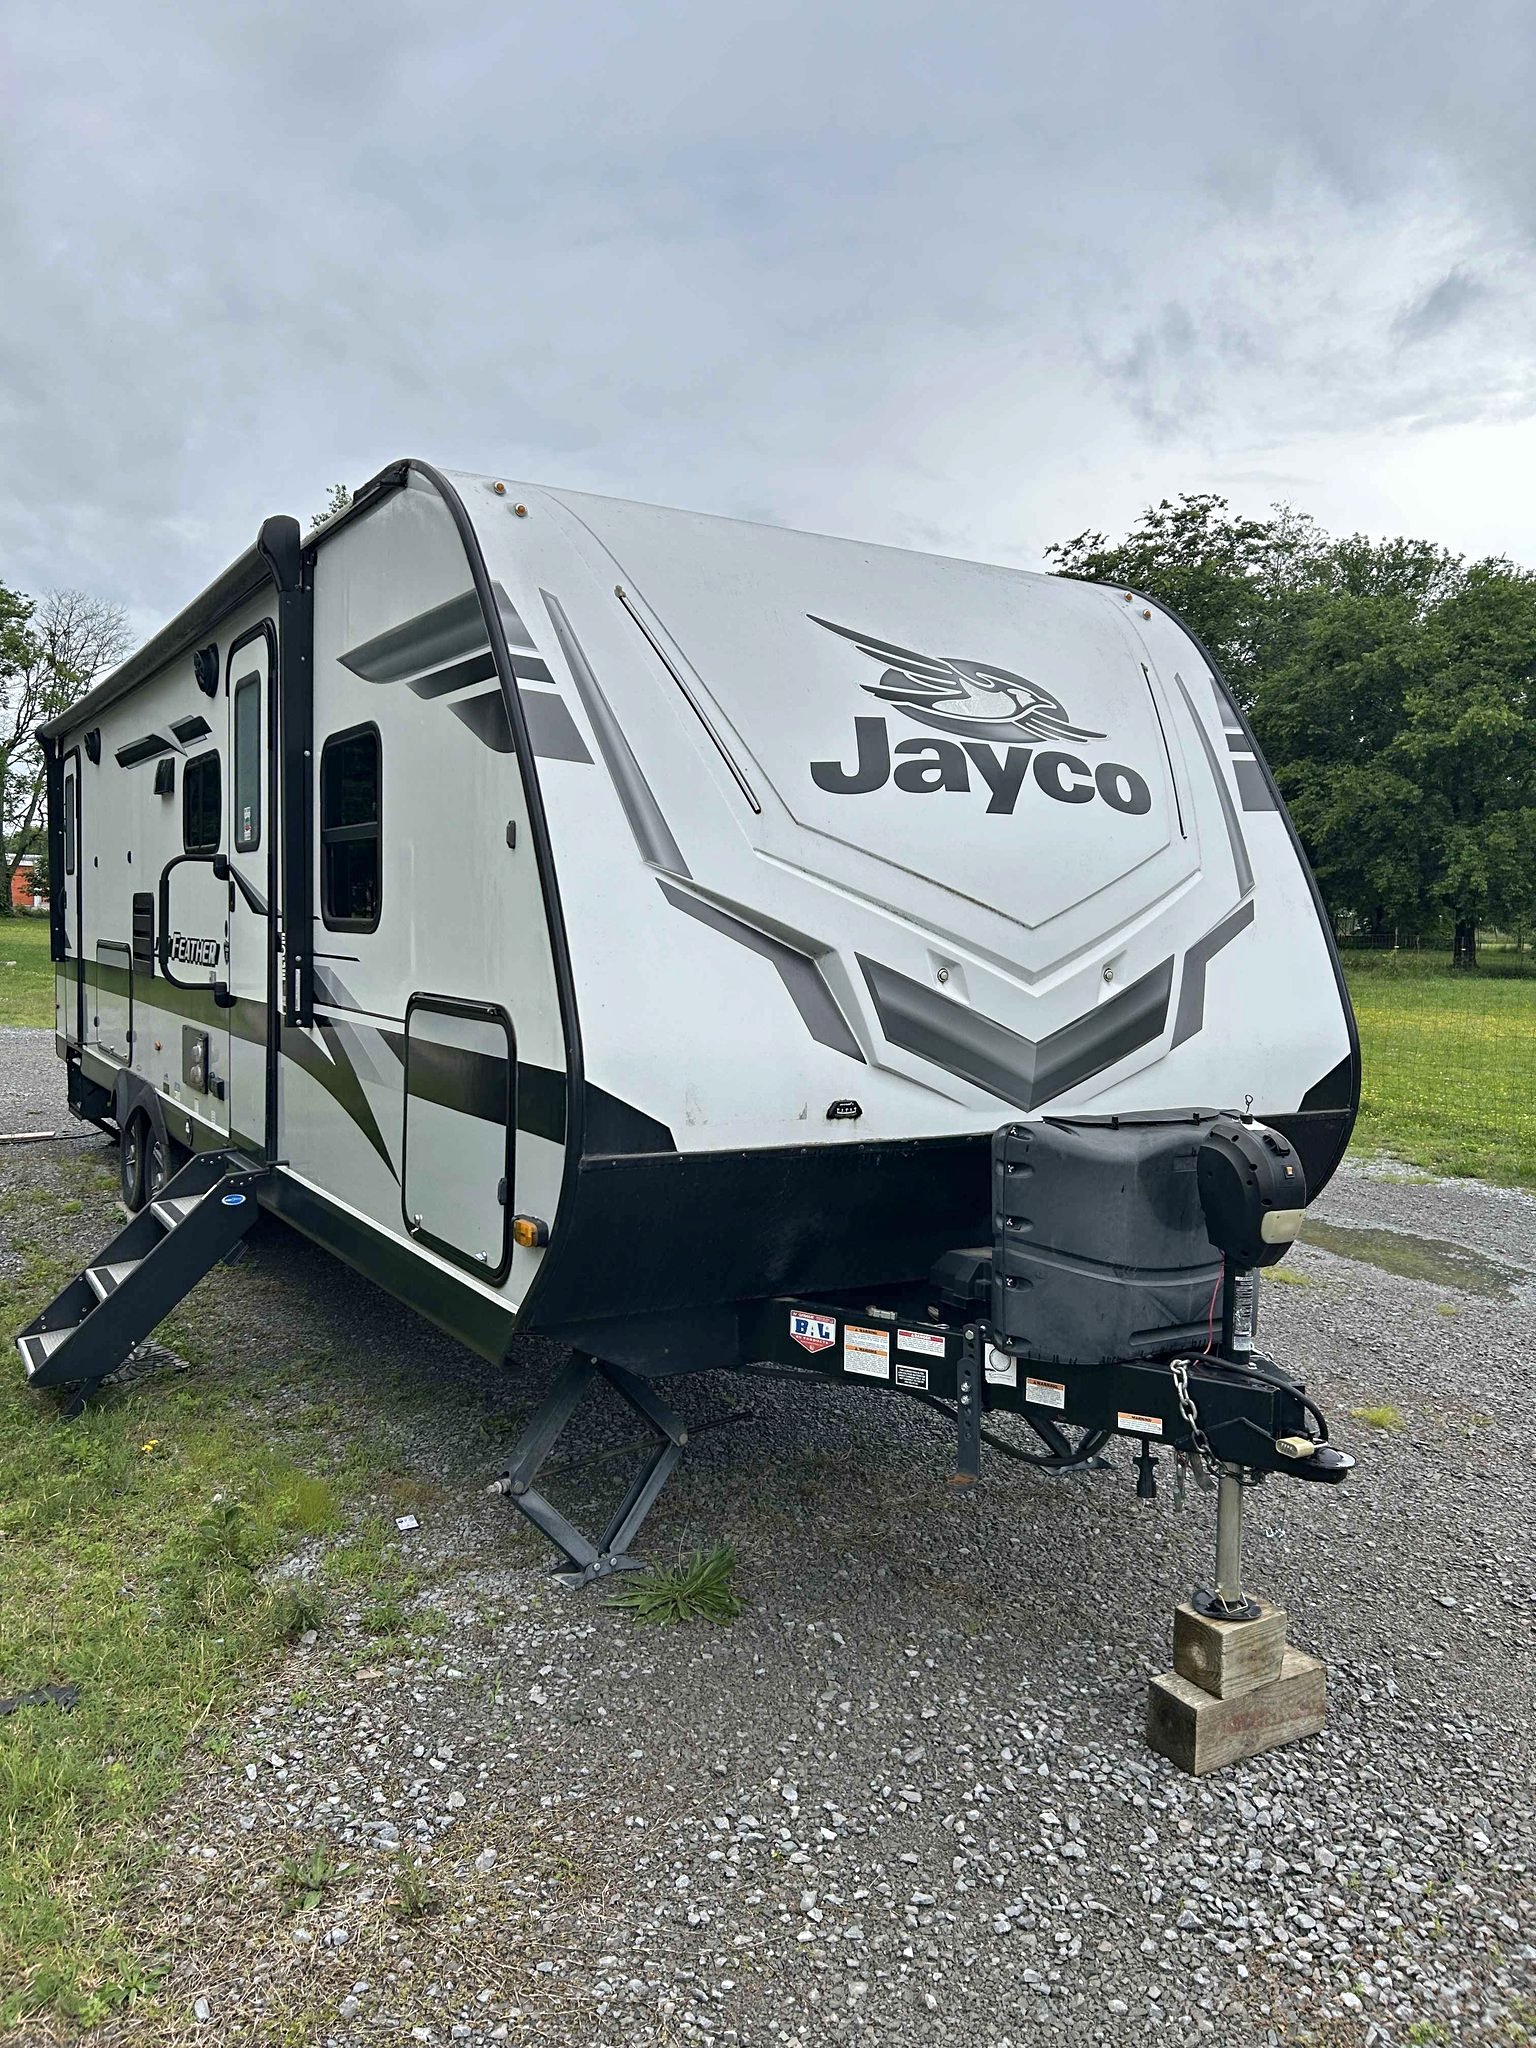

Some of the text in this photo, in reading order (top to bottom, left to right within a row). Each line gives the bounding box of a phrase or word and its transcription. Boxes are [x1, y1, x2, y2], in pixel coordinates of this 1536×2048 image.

[810, 716, 1152, 815] Jayco
[170, 932, 220, 967] FEATHER
[795, 1318, 830, 1340] BAL
